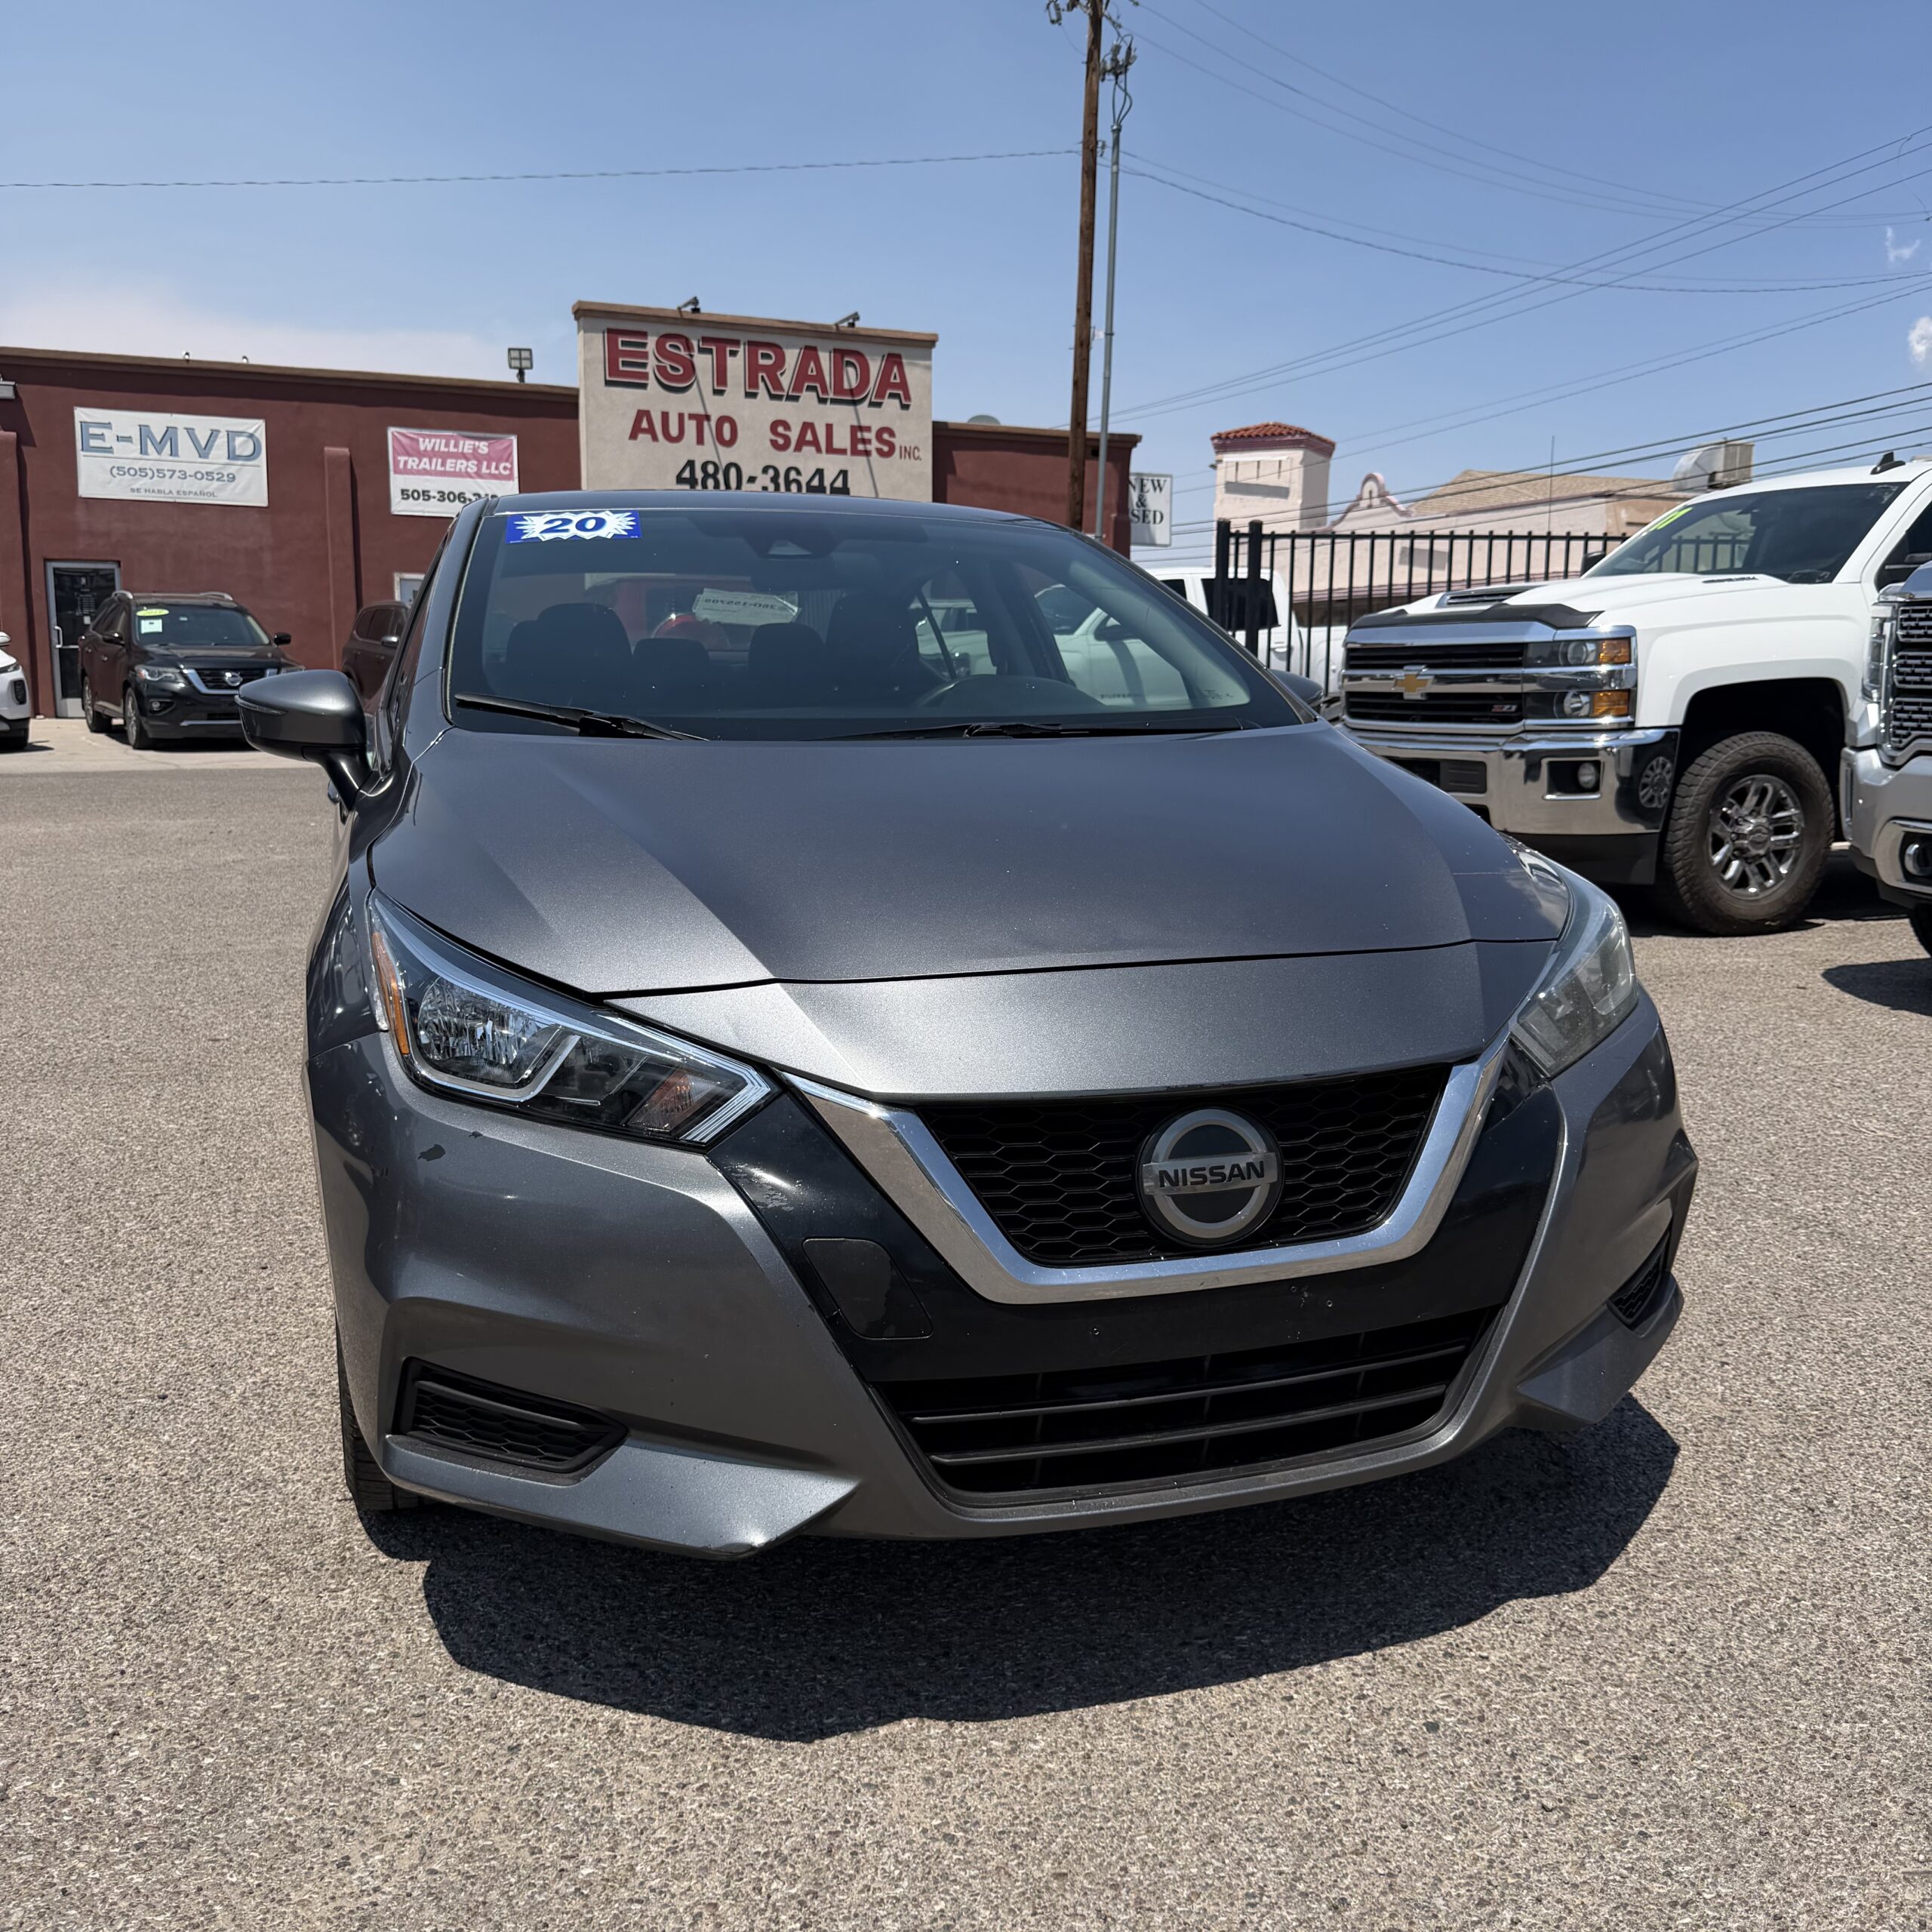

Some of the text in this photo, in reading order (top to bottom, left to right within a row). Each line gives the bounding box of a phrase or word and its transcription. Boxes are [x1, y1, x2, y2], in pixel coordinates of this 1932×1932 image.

[604, 328, 912, 411] ESTRADA
[80, 421, 263, 462] E-MVD
[628, 409, 922, 462] AUTO SALES INC.
[419, 437, 490, 455] WILLIE'S
[109, 465, 236, 483] (505)573-0529
[397, 456, 512, 475] TRAILERS LLC
[675, 459, 851, 495] 480-3644
[145, 488, 174, 496] HABLA
[1136, 494, 1147, 509] &
[539, 516, 607, 534] 20
[1130, 508, 1164, 525] SED
[1158, 1160, 1265, 1188] NISSAN
